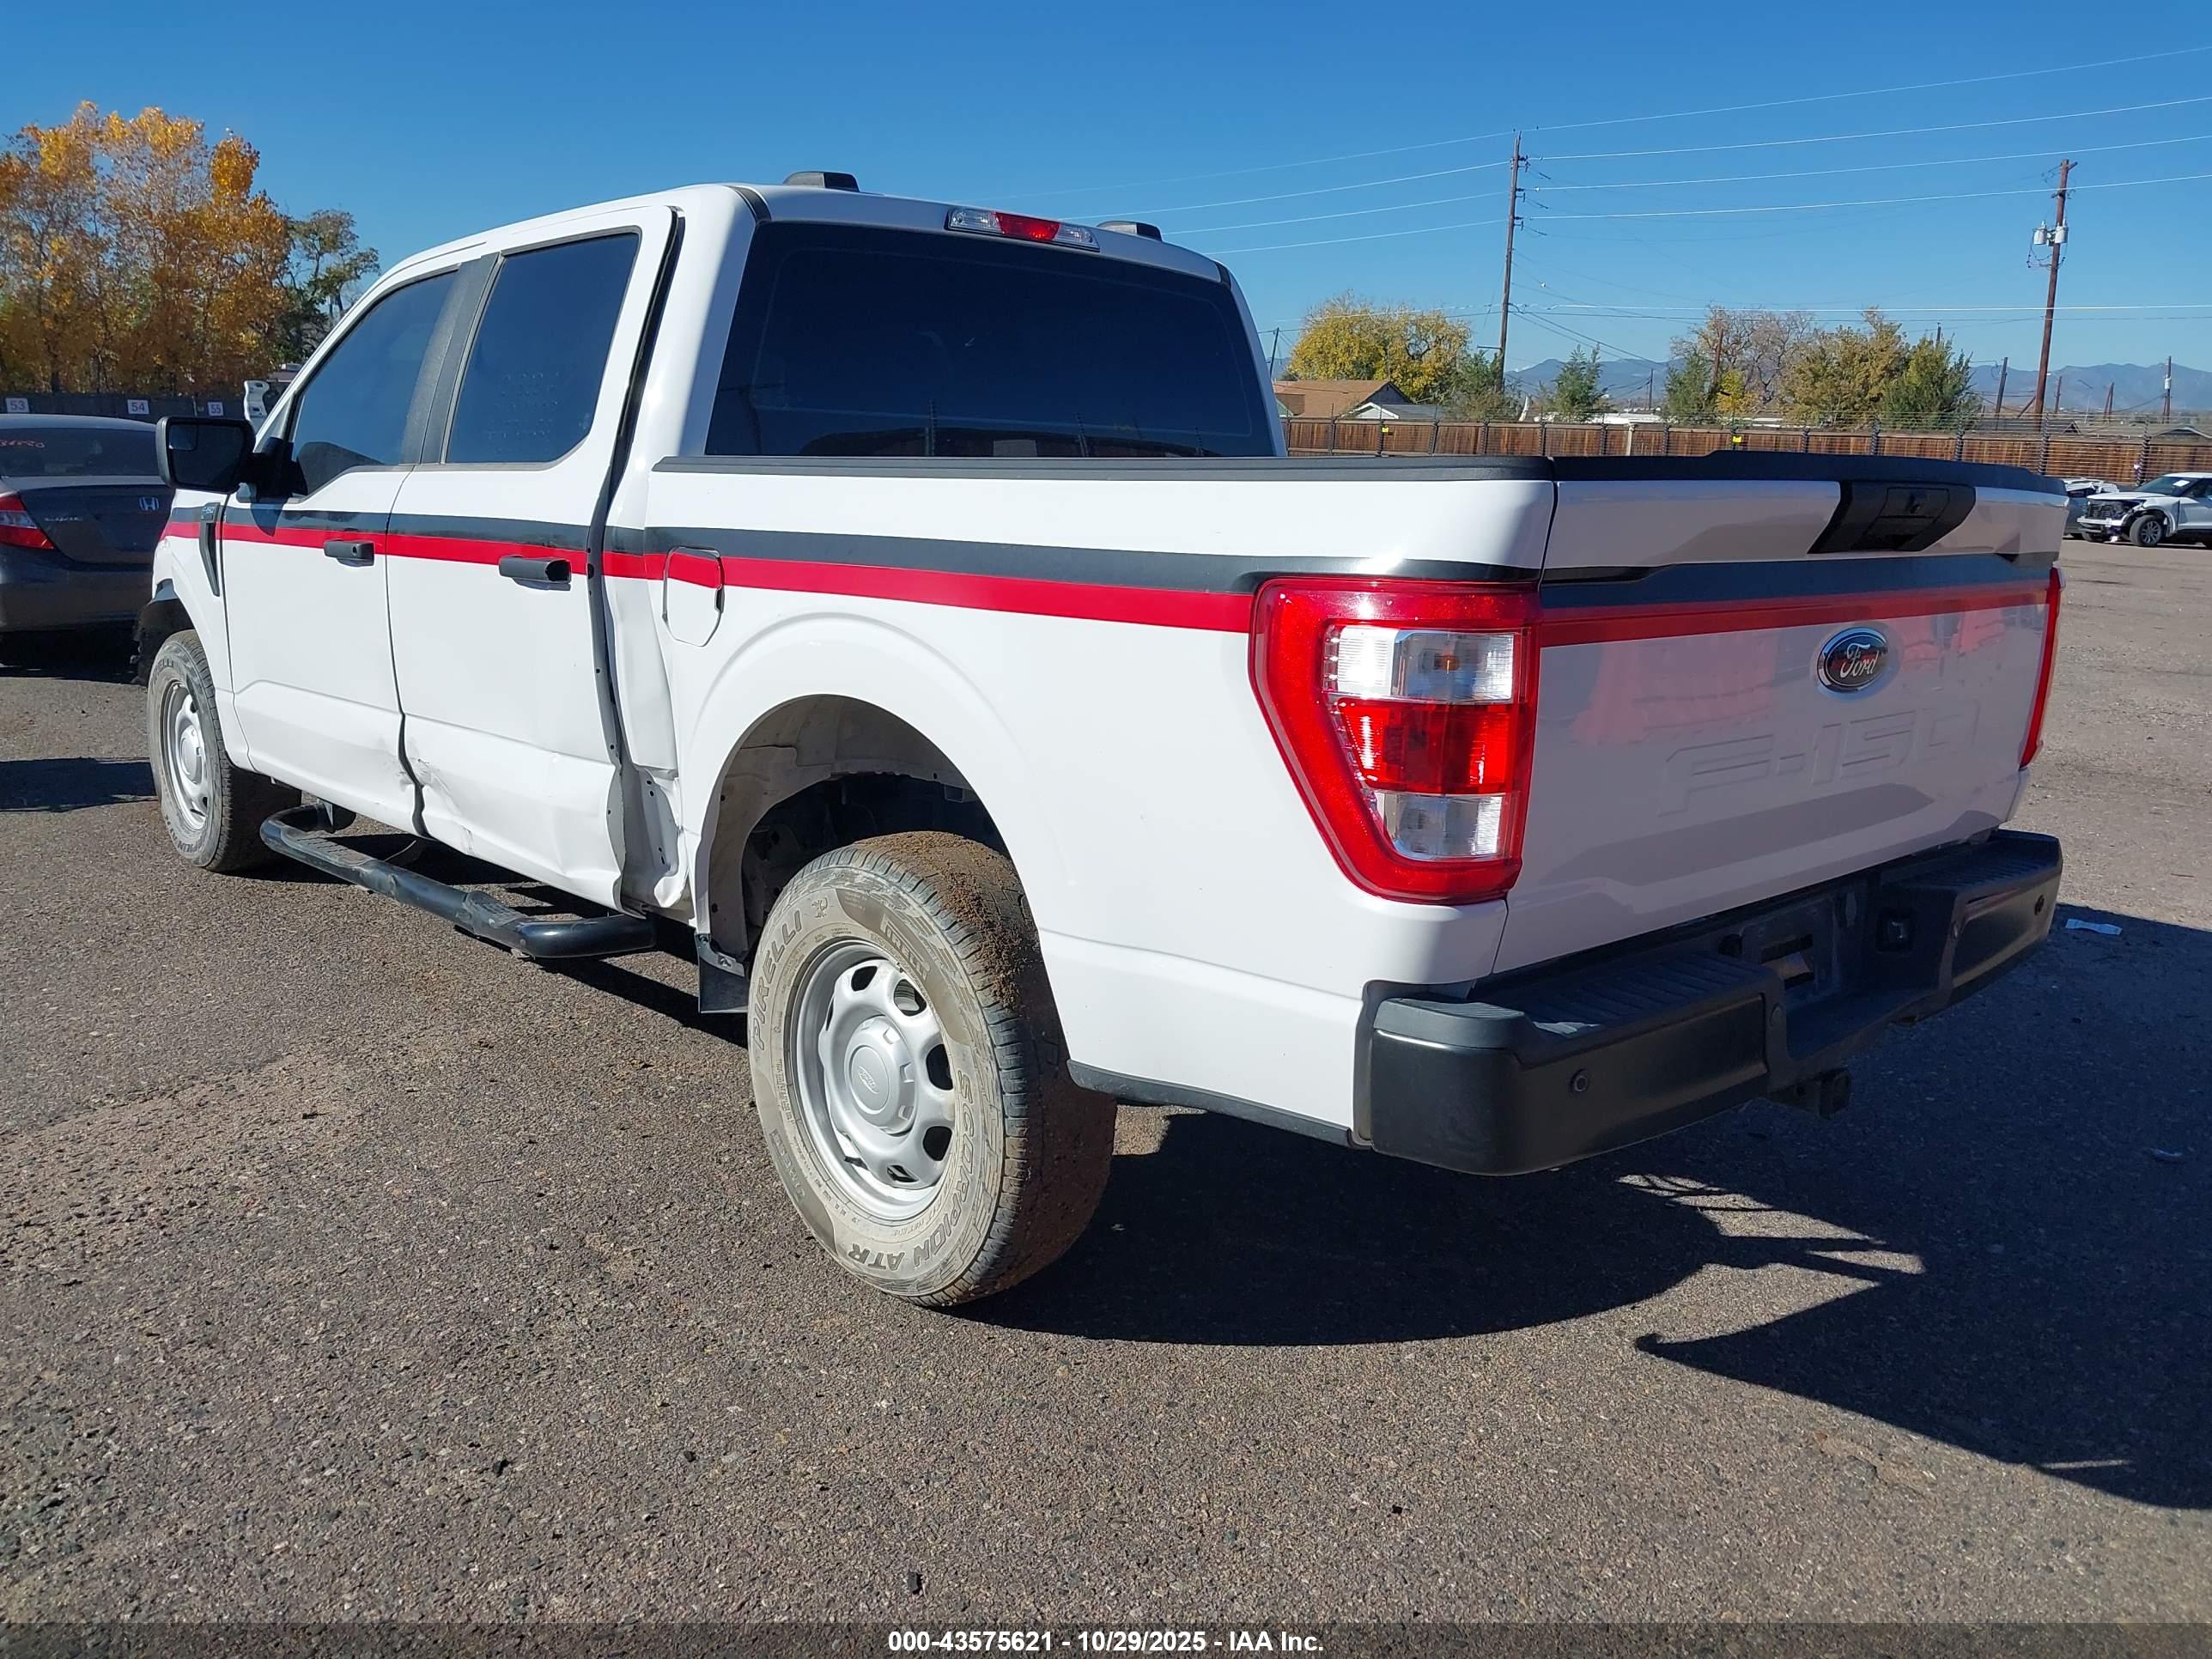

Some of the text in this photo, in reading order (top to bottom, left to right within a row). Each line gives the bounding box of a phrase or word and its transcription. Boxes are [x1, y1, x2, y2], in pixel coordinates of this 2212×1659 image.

[10, 400, 26, 410] 53
[131, 402, 145, 412] 54
[210, 404, 222, 414] 55
[1839, 642, 1880, 678] Ford
[1657, 697, 1981, 817] F-150
[753, 910, 802, 1050] PIRELLI
[913, 1069, 975, 1267] SCORPION
[848, 1243, 905, 1272] ATR
